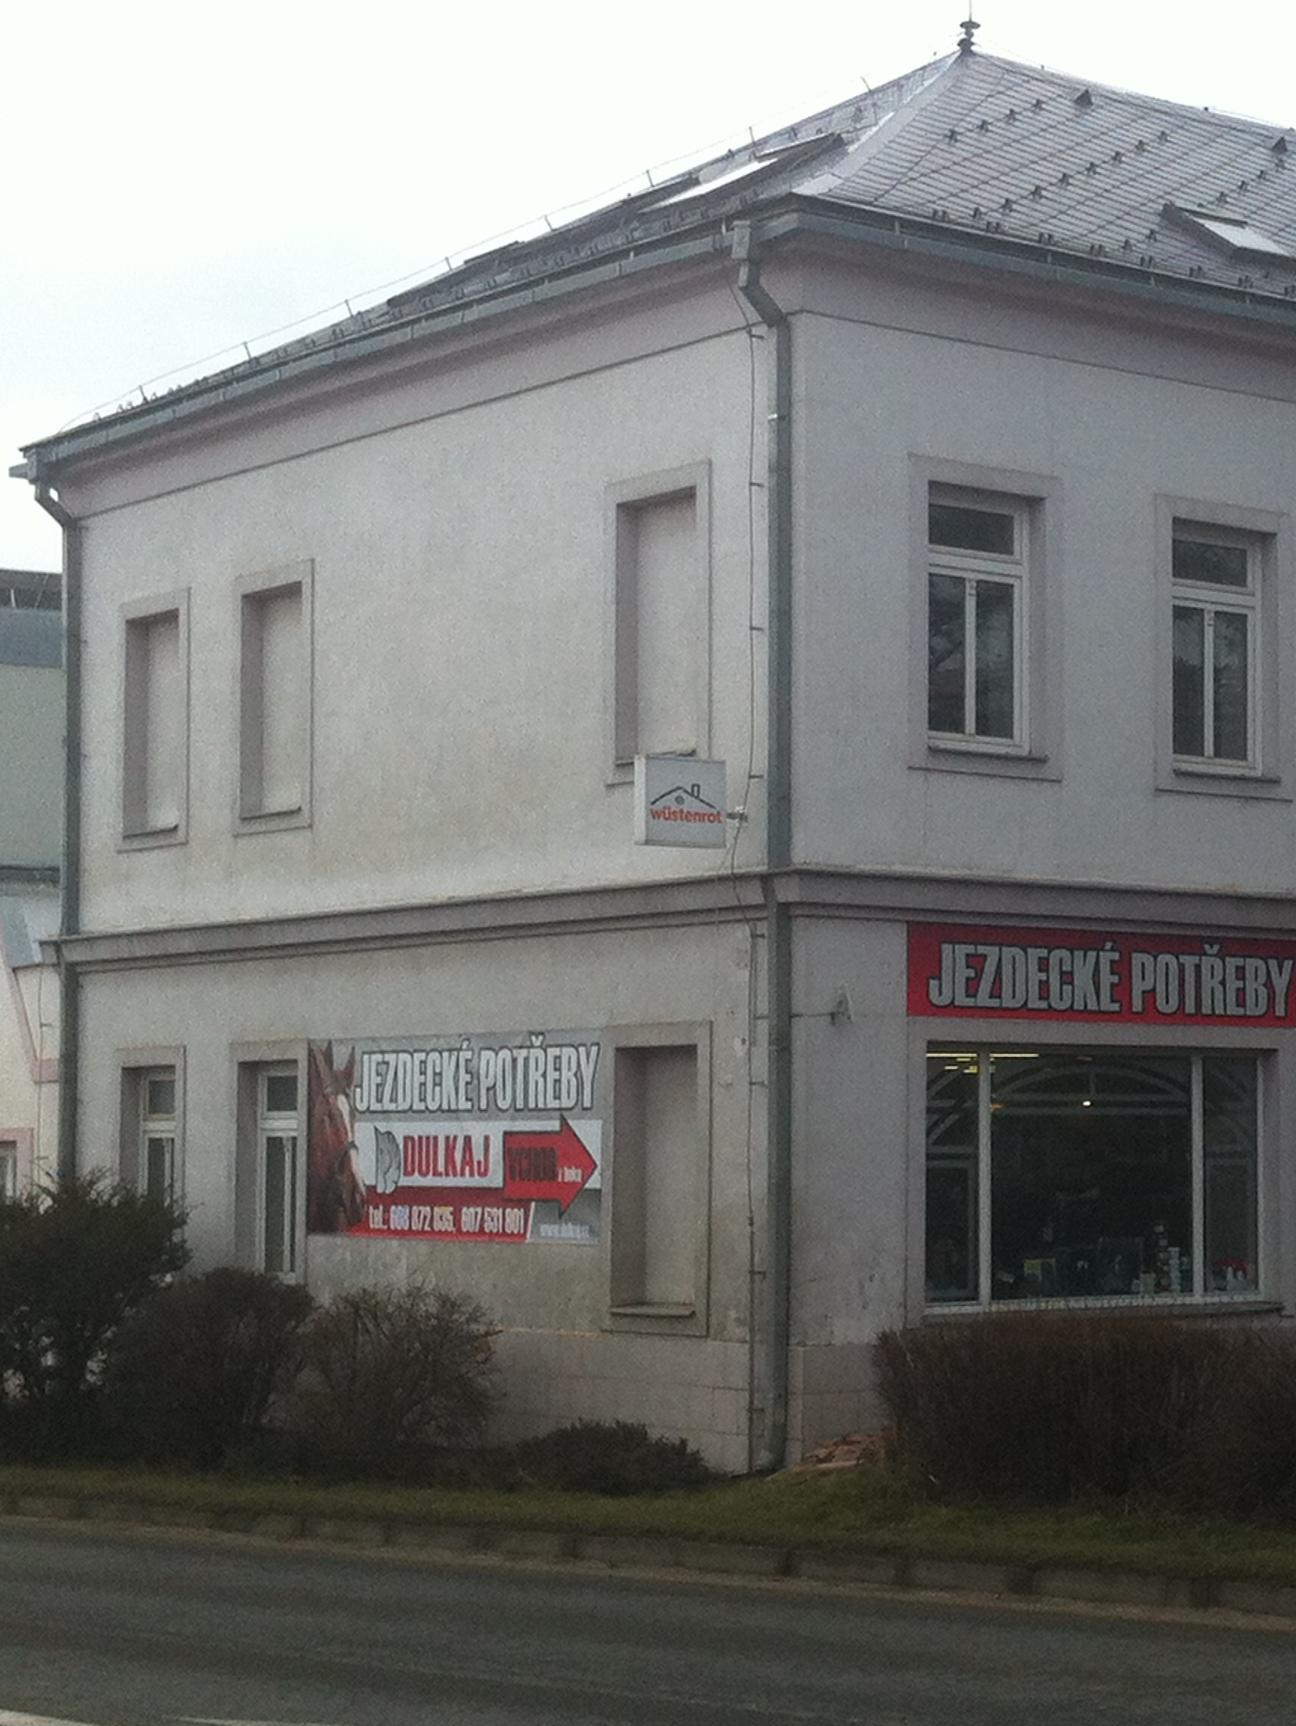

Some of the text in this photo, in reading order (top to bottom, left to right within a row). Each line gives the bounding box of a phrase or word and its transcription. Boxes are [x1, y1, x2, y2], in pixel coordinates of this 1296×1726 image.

[650, 806, 722, 824] wüstenrot
[928, 941, 1293, 1017] JEZDECKÉ POTŘEBY
[355, 1035, 599, 1113] JEZDECKÉ POTŘEBY
[403, 1135, 490, 1178] DULKAJ
